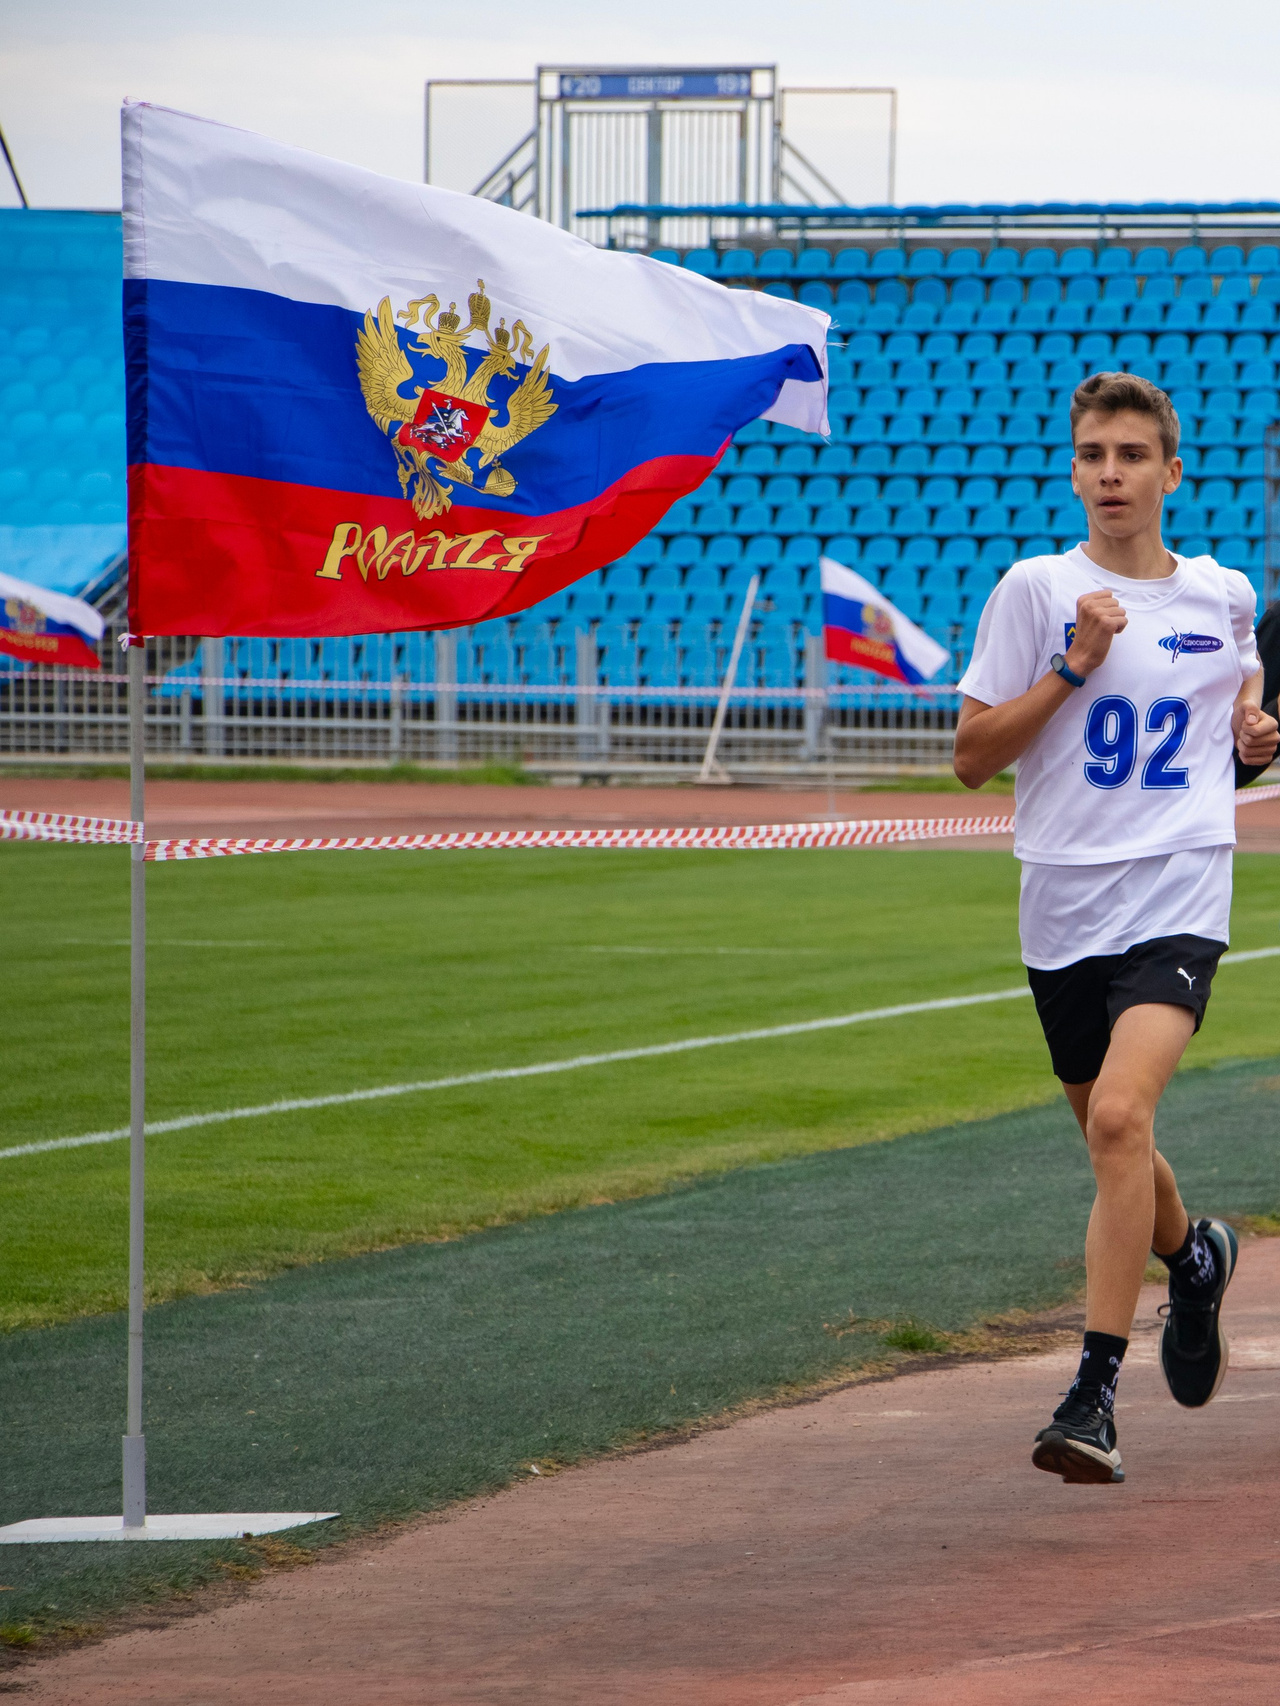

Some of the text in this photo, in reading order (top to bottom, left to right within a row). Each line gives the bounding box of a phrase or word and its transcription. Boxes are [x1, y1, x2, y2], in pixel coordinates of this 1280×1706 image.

[574, 75, 601, 96] 20
[315, 522, 553, 582] РОССИЯ
[1084, 695, 1191, 790] 92
